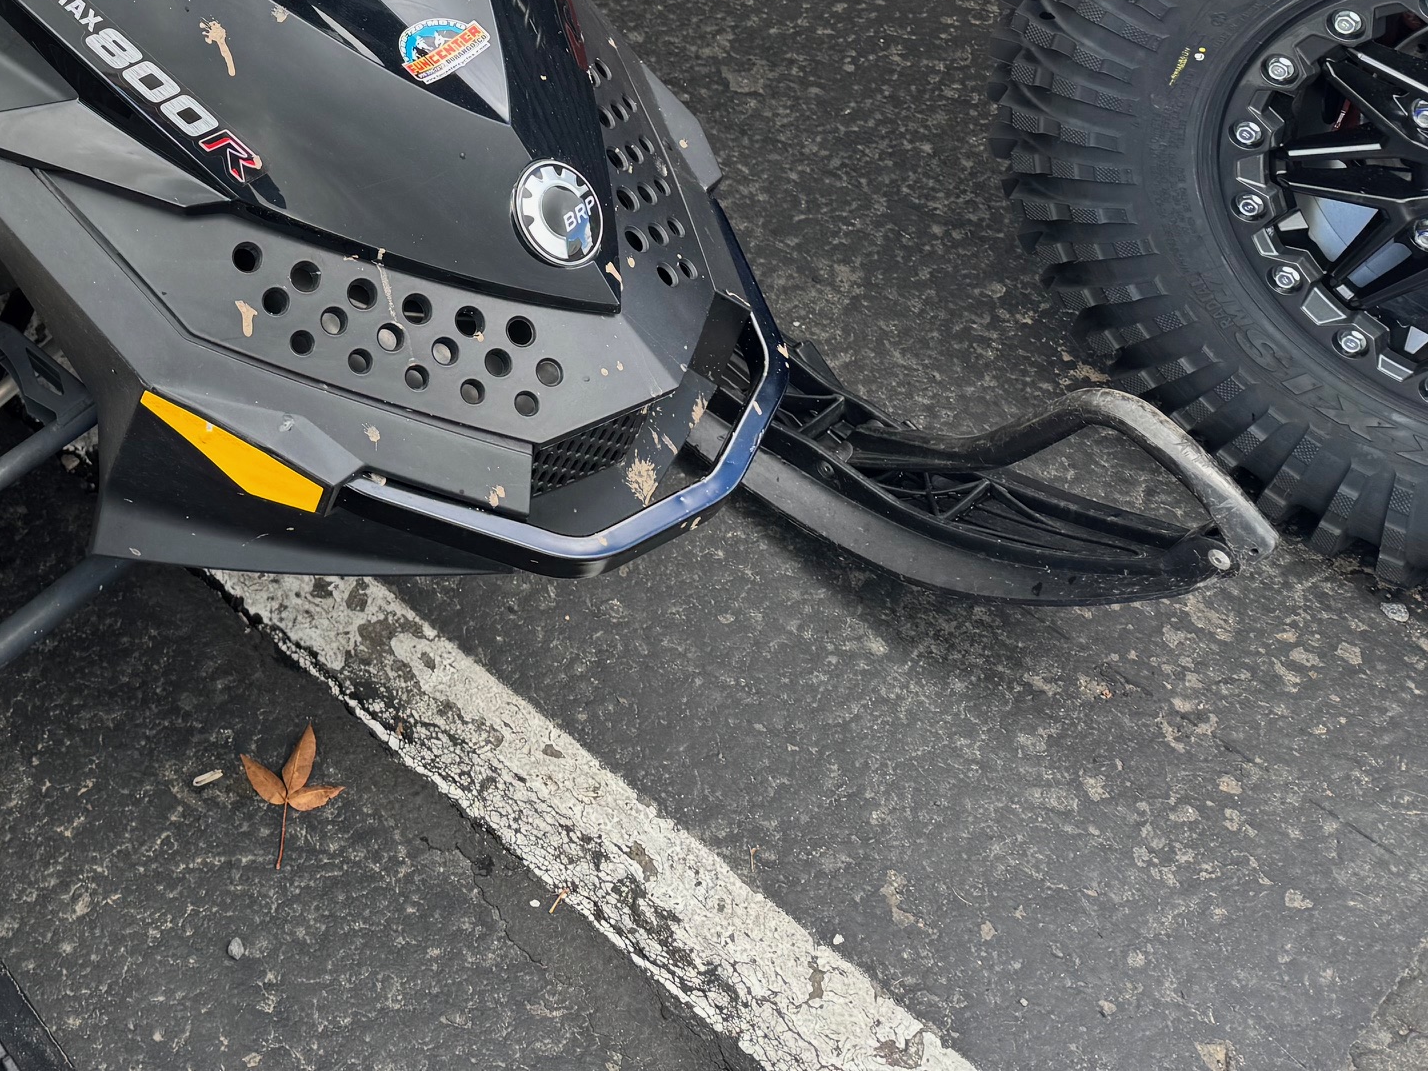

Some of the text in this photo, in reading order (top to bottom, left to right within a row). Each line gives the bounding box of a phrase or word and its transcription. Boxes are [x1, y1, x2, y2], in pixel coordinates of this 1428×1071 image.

[406, 56, 431, 75] FUN
[429, 25, 482, 65] CENTER
[85, 27, 262, 183] 800R
[563, 195, 595, 233] BRP
